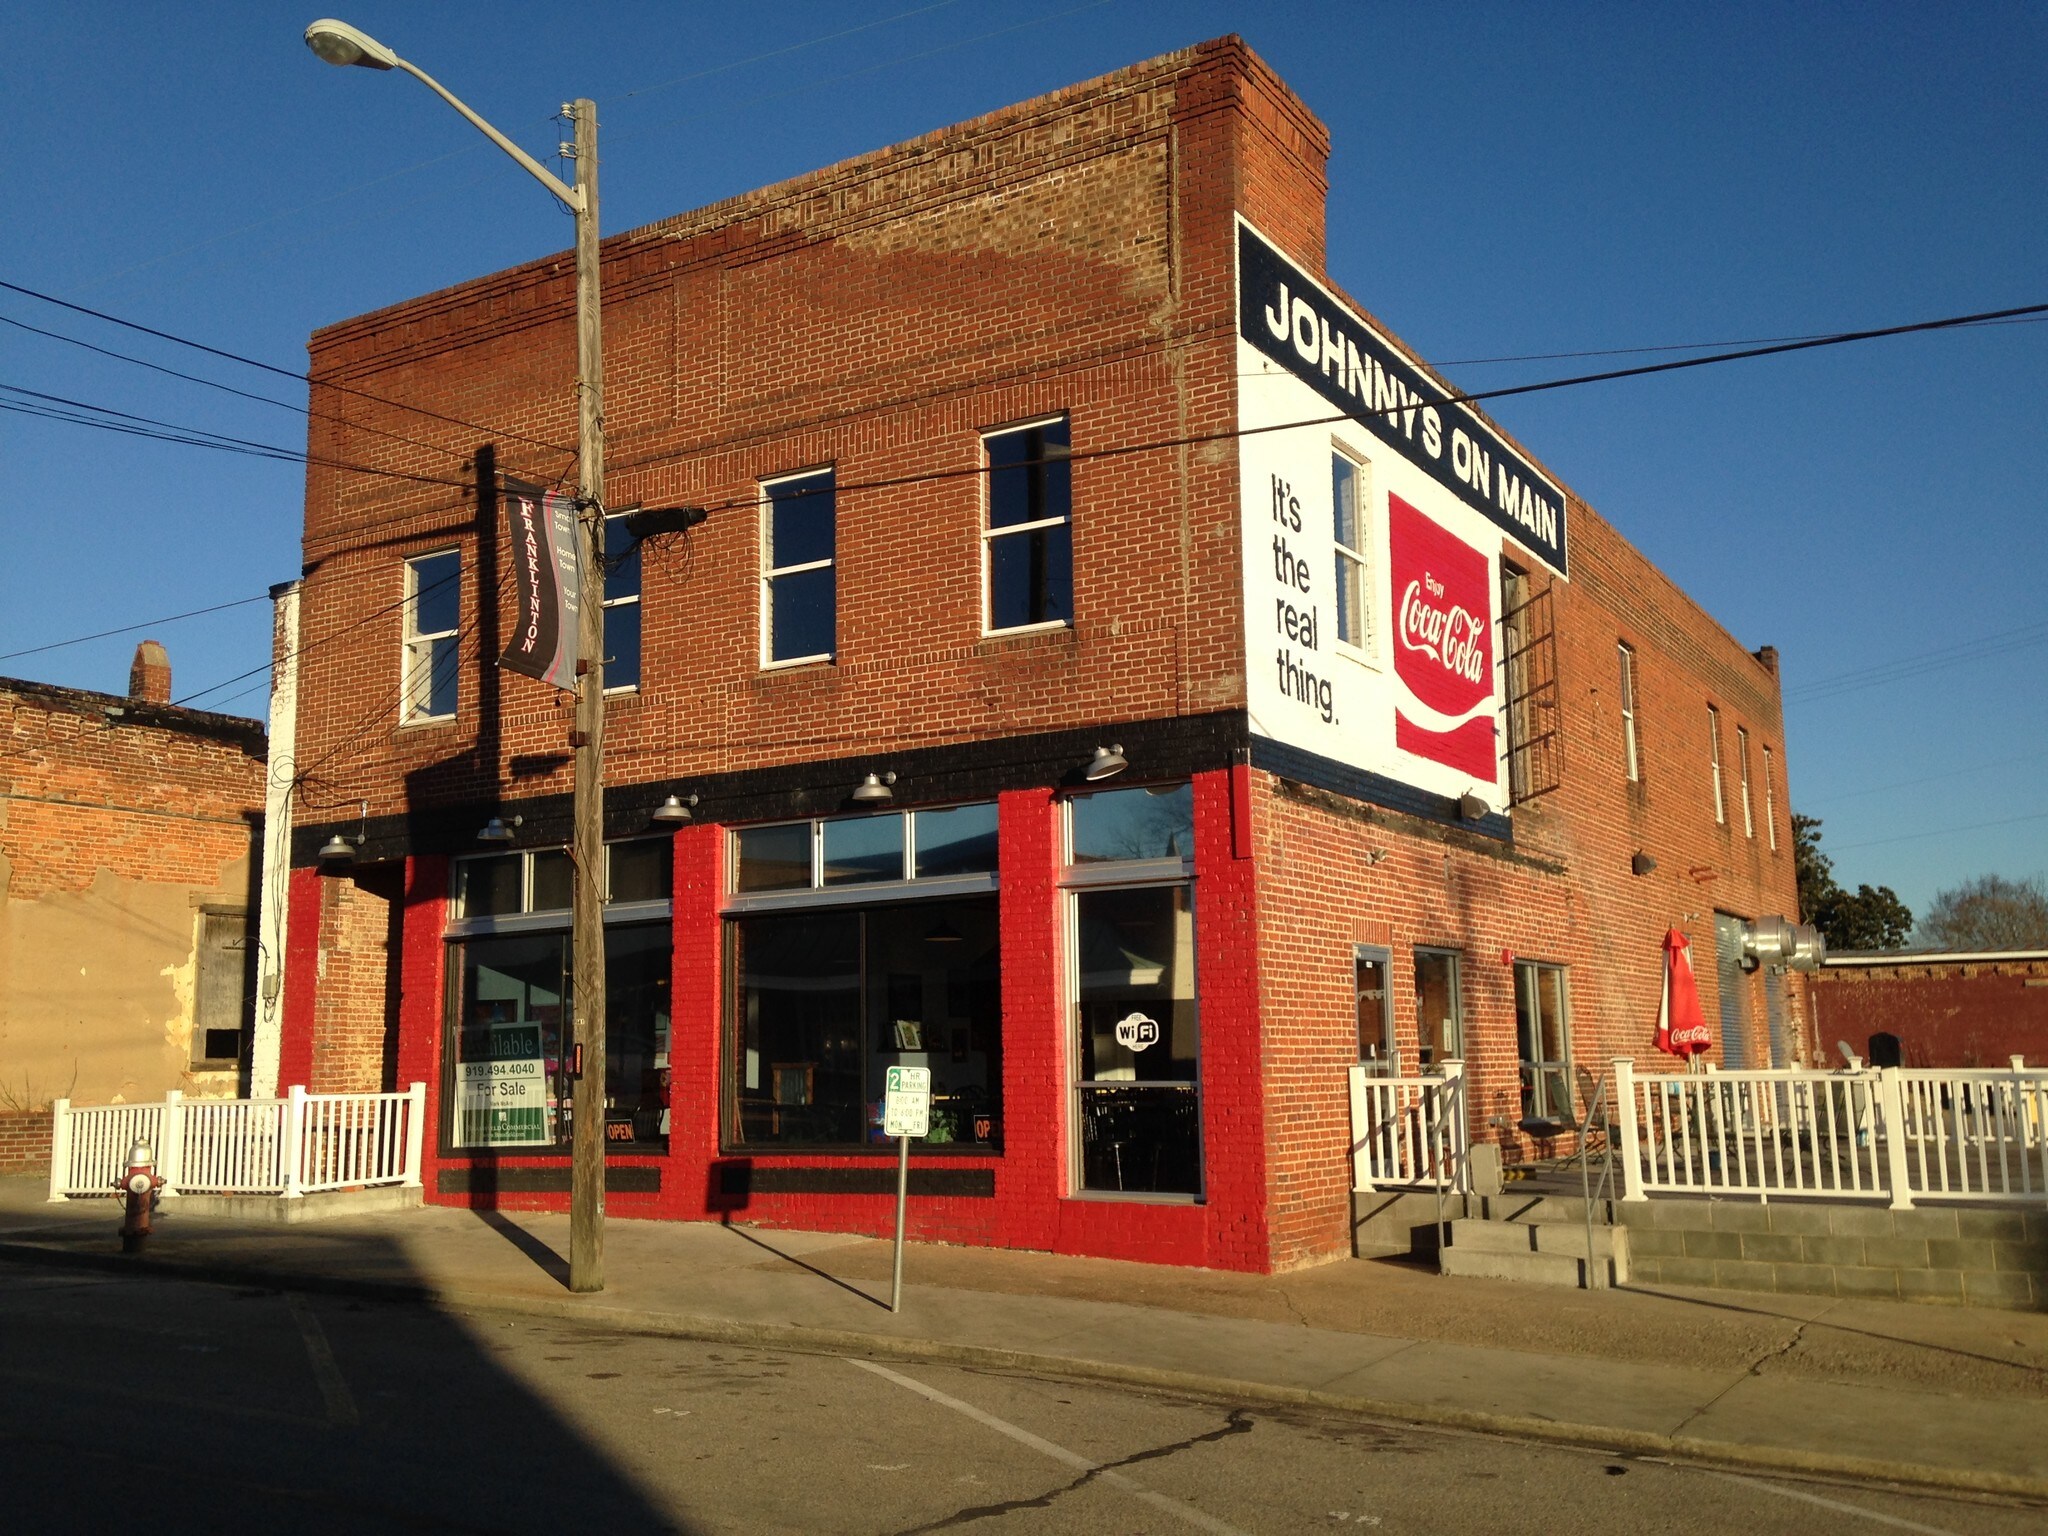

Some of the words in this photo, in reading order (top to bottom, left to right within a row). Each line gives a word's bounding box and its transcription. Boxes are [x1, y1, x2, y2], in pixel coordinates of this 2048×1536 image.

[1266, 283, 1442, 459] JOHNNY'S
[1452, 427, 1490, 500] ON
[1499, 462, 1557, 550] MAIN
[1272, 473, 1301, 533] It's
[557, 545, 576, 560] Home
[559, 559, 575, 573] Town
[1273, 534, 1310, 593] the
[518, 496, 540, 654] FRANKLINTON
[563, 586, 577, 598] Your
[1425, 571, 1445, 599] Enjoy
[565, 599, 579, 613] Town
[1276, 598, 1317, 651] real
[1400, 580, 1485, 684] Coca-Cola
[1277, 648, 1339, 725] thing.
[1671, 1025, 1710, 1045] Coca-Cola
[466, 1063, 535, 1077] 919.494.4040
[477, 1083, 497, 1097] For
[500, 1082, 526, 1095] Sale
[889, 1072, 900, 1090] 2
[910, 1072, 921, 1080] HR
[901, 1081, 927, 1090] PARKING
[607, 1124, 633, 1140] OPEN
